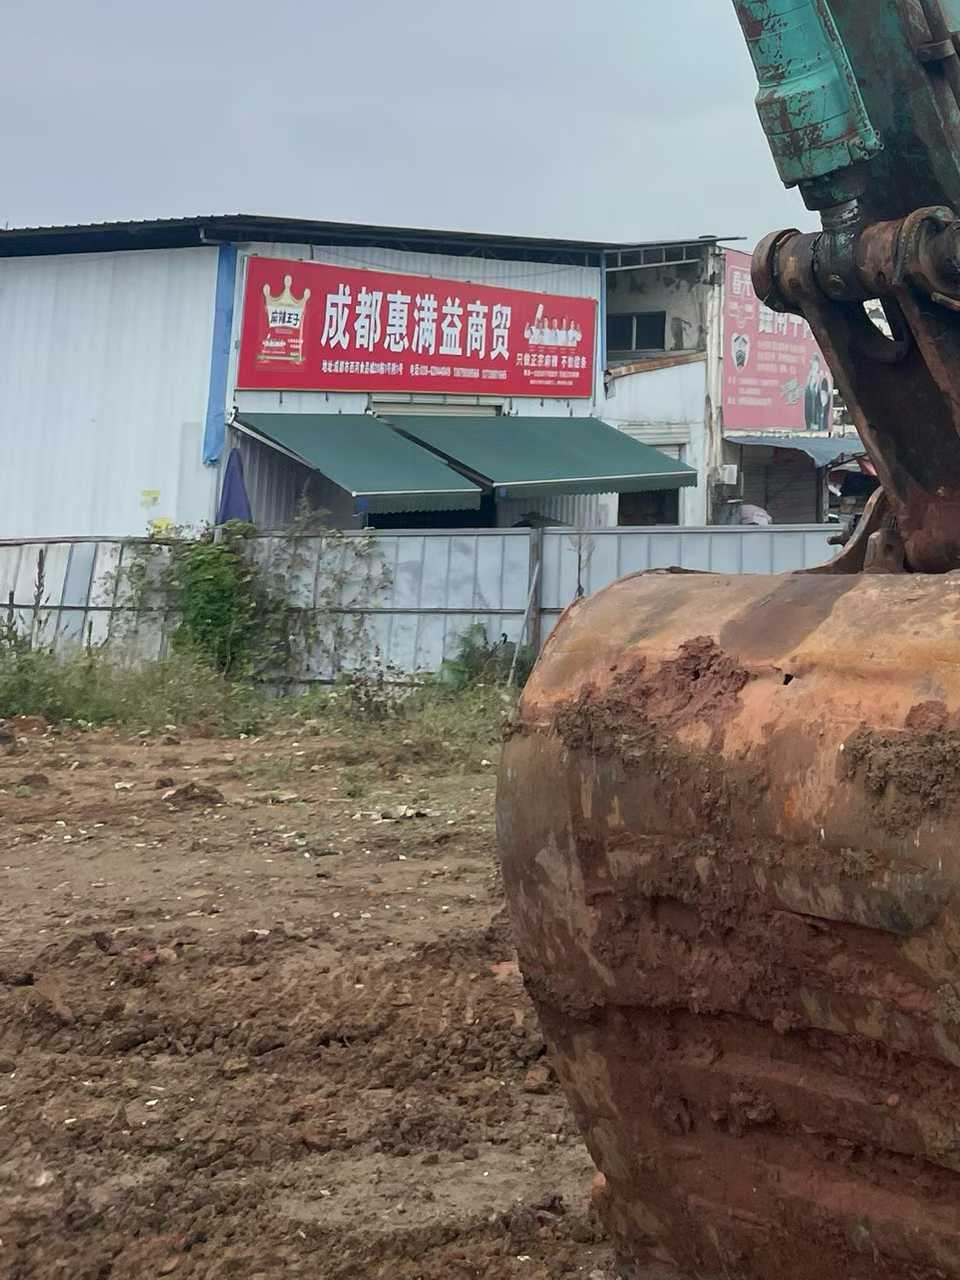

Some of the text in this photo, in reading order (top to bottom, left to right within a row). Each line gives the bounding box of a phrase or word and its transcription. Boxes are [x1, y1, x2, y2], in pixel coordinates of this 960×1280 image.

[320, 283, 512, 361] 成都惠满益商贸
